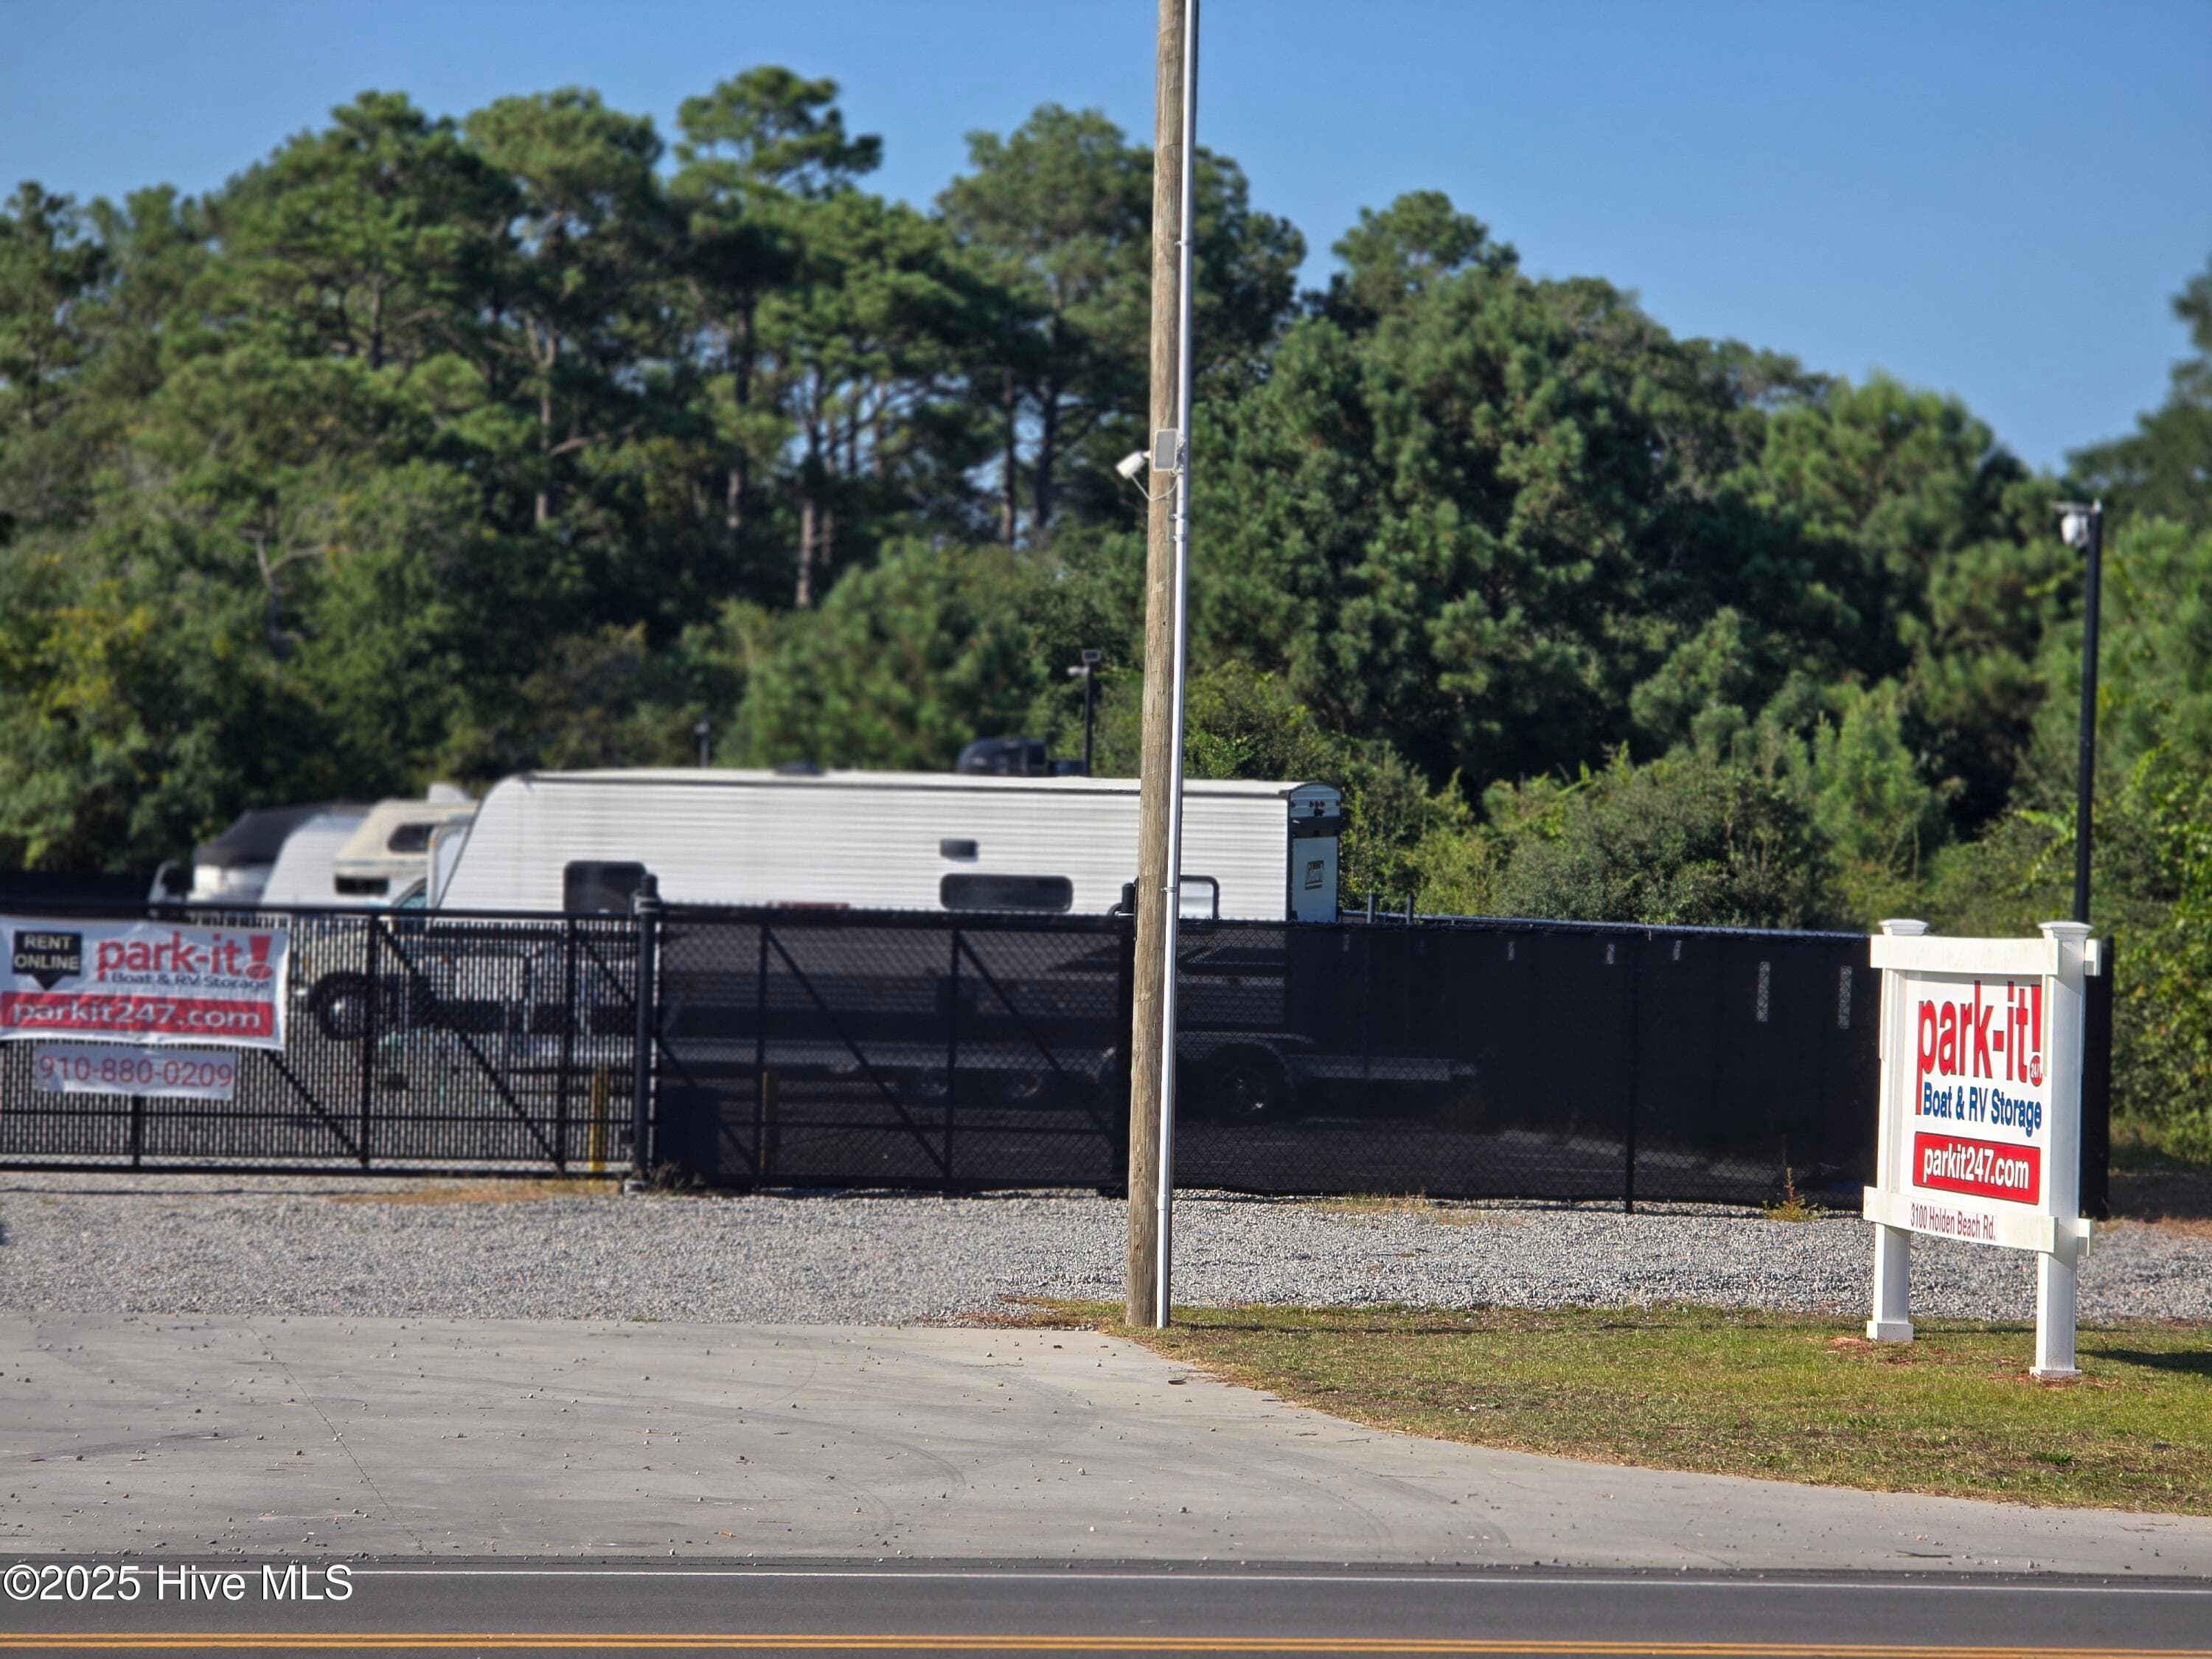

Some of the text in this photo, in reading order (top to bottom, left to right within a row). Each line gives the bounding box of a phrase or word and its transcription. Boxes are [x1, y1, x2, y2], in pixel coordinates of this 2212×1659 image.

[24, 934, 72, 950] RENT
[14, 954, 80, 970] ONLINE
[111, 972, 270, 990] Boat & RV Storage
[13, 1000, 262, 1029] parkit247.com
[38, 1054, 232, 1088] 910-880-0209
[1923, 1082, 2042, 1138] Boat & RV Storage
[1923, 1147, 2030, 1189] parkit247.com
[1910, 1203, 1996, 1241] 3100 Holden Beach Rd.
